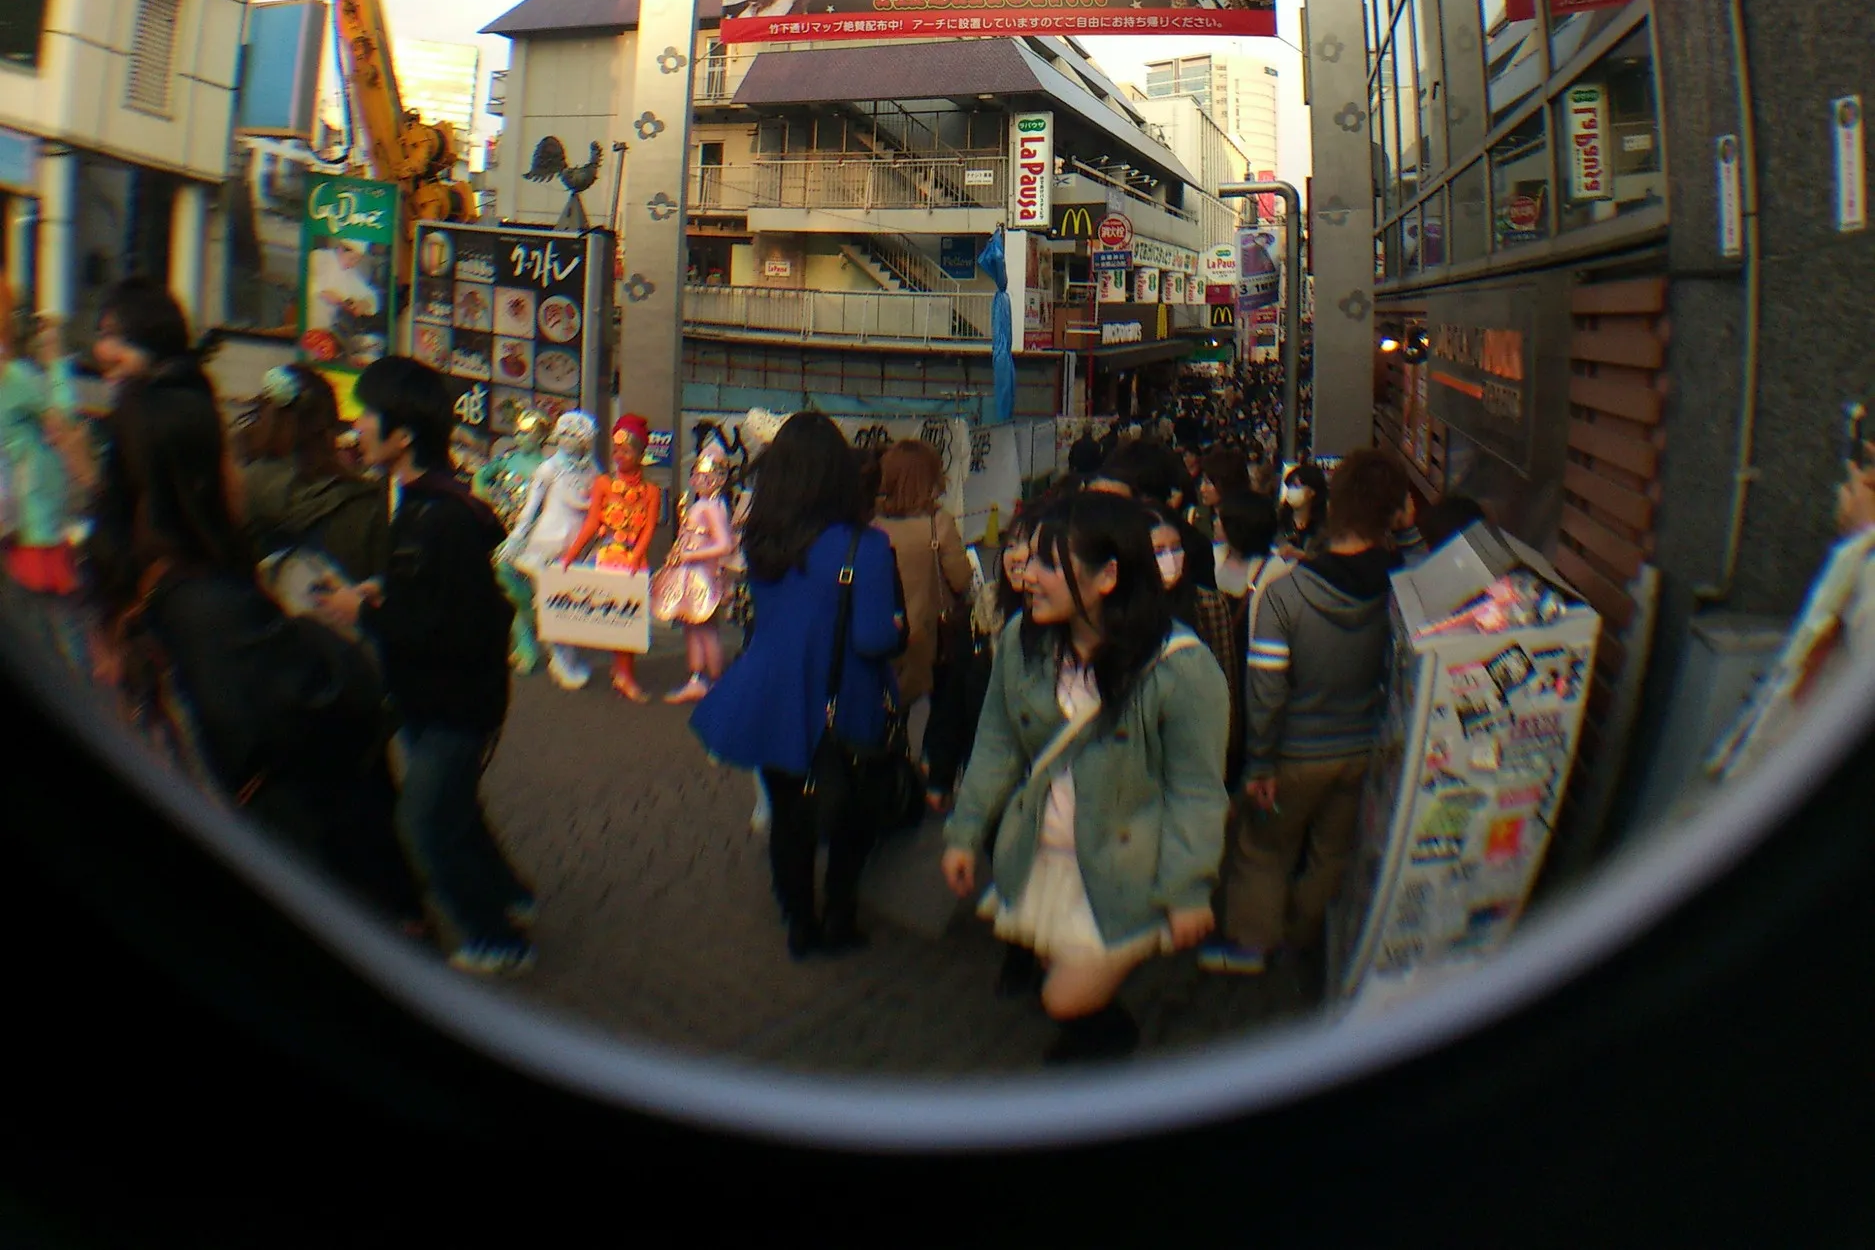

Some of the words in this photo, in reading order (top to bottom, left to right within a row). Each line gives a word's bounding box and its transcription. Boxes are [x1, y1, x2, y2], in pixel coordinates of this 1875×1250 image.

[1020, 136, 1045, 159] La
[1017, 162, 1045, 220] Pausa
[1101, 226, 1126, 238] 消火栓
[1217, 258, 1236, 269] Paus
